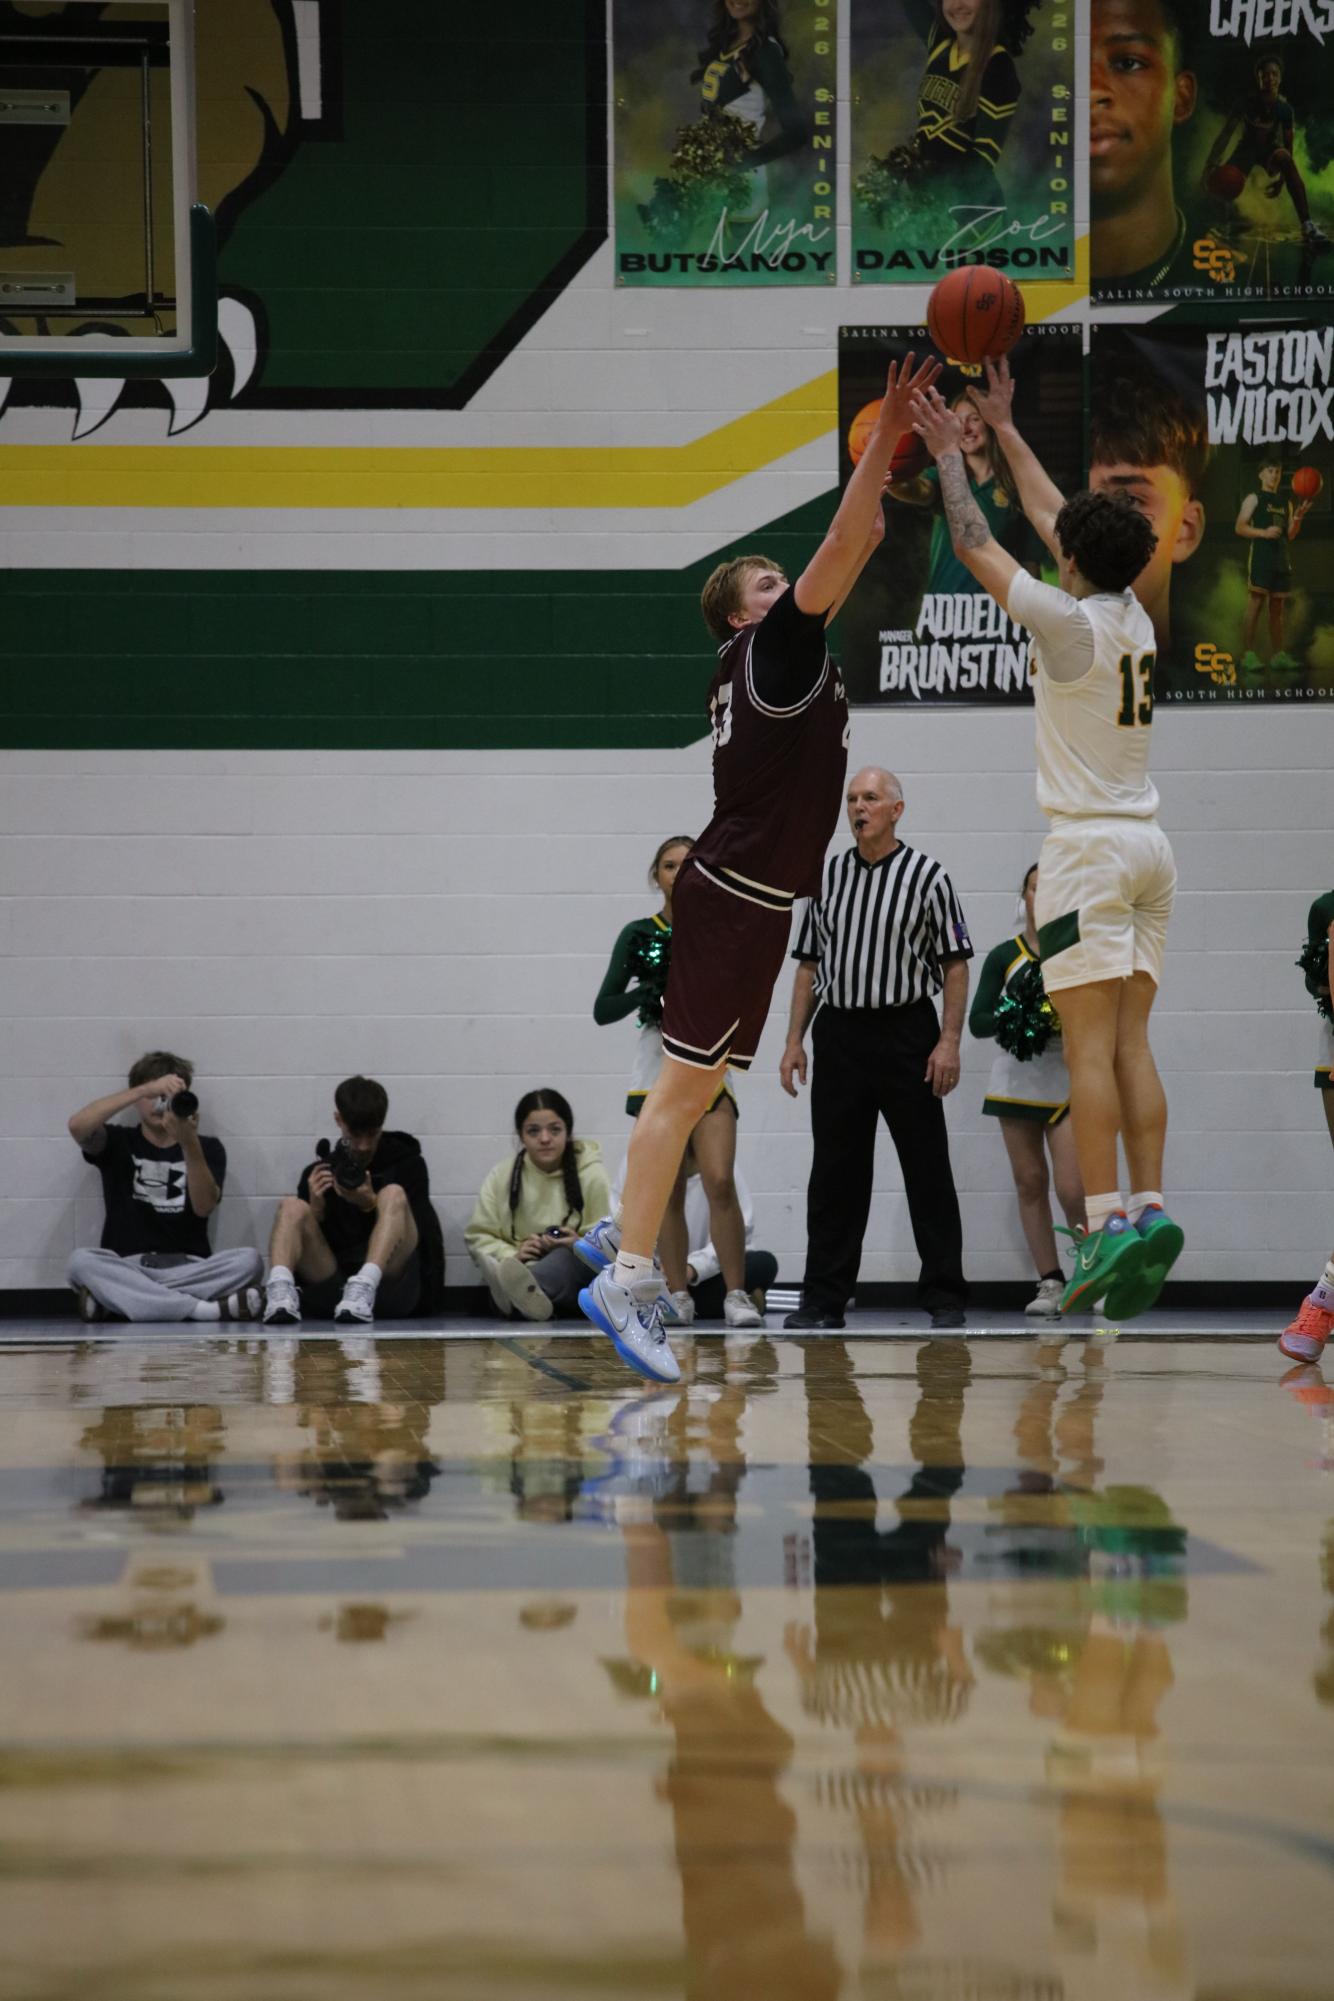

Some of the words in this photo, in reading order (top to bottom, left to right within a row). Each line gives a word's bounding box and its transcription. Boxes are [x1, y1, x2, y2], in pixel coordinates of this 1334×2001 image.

[1052, 0, 1067, 51] 26
[812, 88, 832, 219] SENIOR
[1050, 84, 1069, 214] SENIOR
[856, 247, 1068, 270] DAVIDSON
[938, 205, 1066, 261] Zoe
[620, 252, 832, 272] BUTSANOY
[1097, 289, 1154, 299] SALINA
[1164, 288, 1215, 298] SOUTH
[1225, 287, 1264, 297] HIGH
[840, 327, 899, 339] SALINA
[1020, 325, 1081, 336] CHOOL
[1204, 326, 1334, 389] EASTON
[1206, 383, 1334, 451] WILCOX
[878, 629, 913, 644] MANAGER
[879, 640, 1033, 700] BRUNSTIN
[1117, 653, 1153, 726] 13
[1165, 690, 1217, 700] SOUTH
[1227, 689, 1265, 699] HIGH
